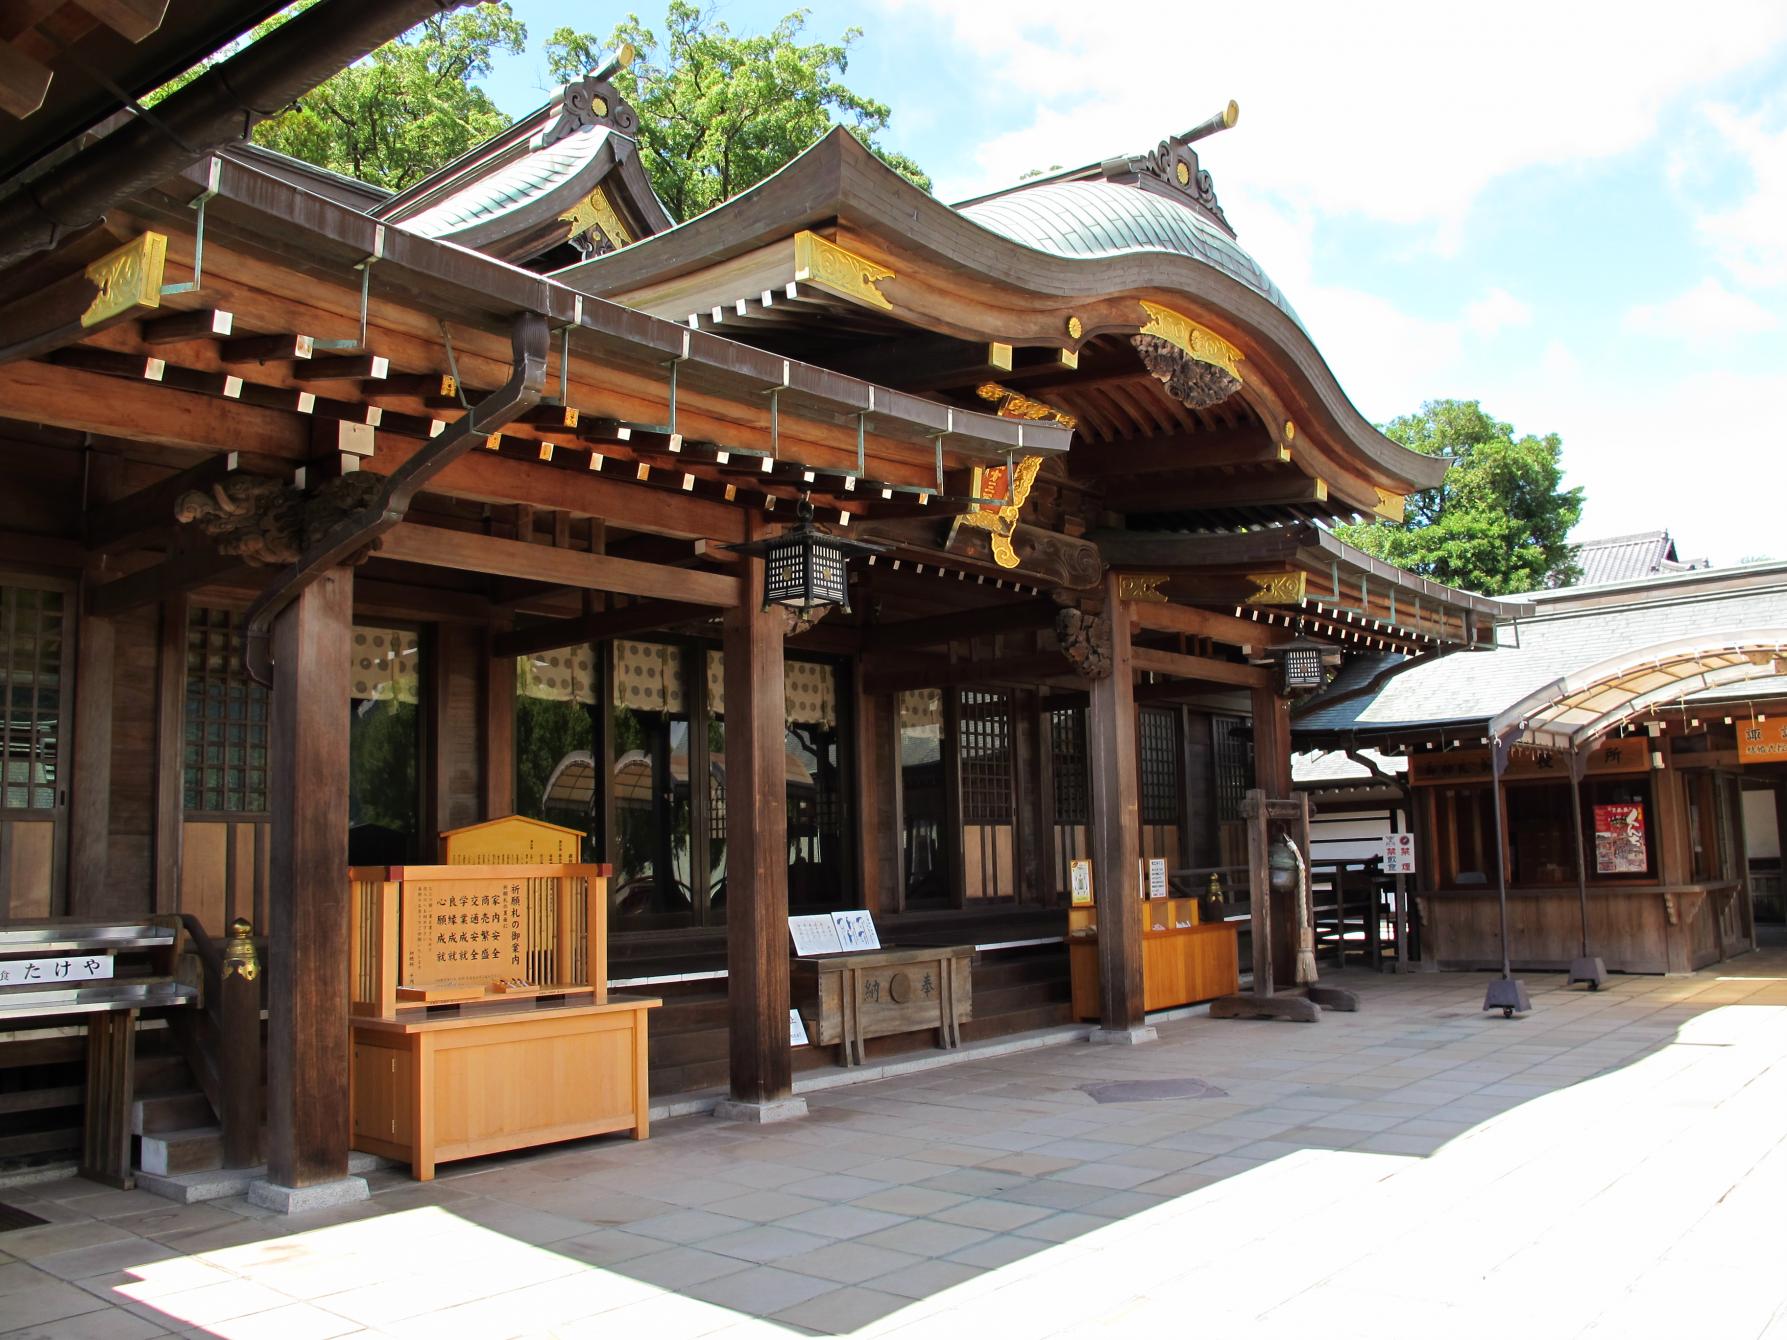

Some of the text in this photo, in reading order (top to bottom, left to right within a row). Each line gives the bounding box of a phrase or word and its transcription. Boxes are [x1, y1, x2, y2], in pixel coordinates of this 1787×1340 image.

[1400, 847, 1411, 872] 禁煙
[436, 897, 447, 962] 心願成就
[447, 895, 458, 962] 良縁成就
[459, 895, 469, 961] 学業成就
[470, 896, 479, 961] 交通安全
[480, 895, 490, 960] 商売繁盛
[491, 894, 501, 959] 家内安全
[511, 884, 521, 966] 祈願札の御案内
[24, 958, 101, 980] たけや
[864, 973, 936, 1003] 奉 納
